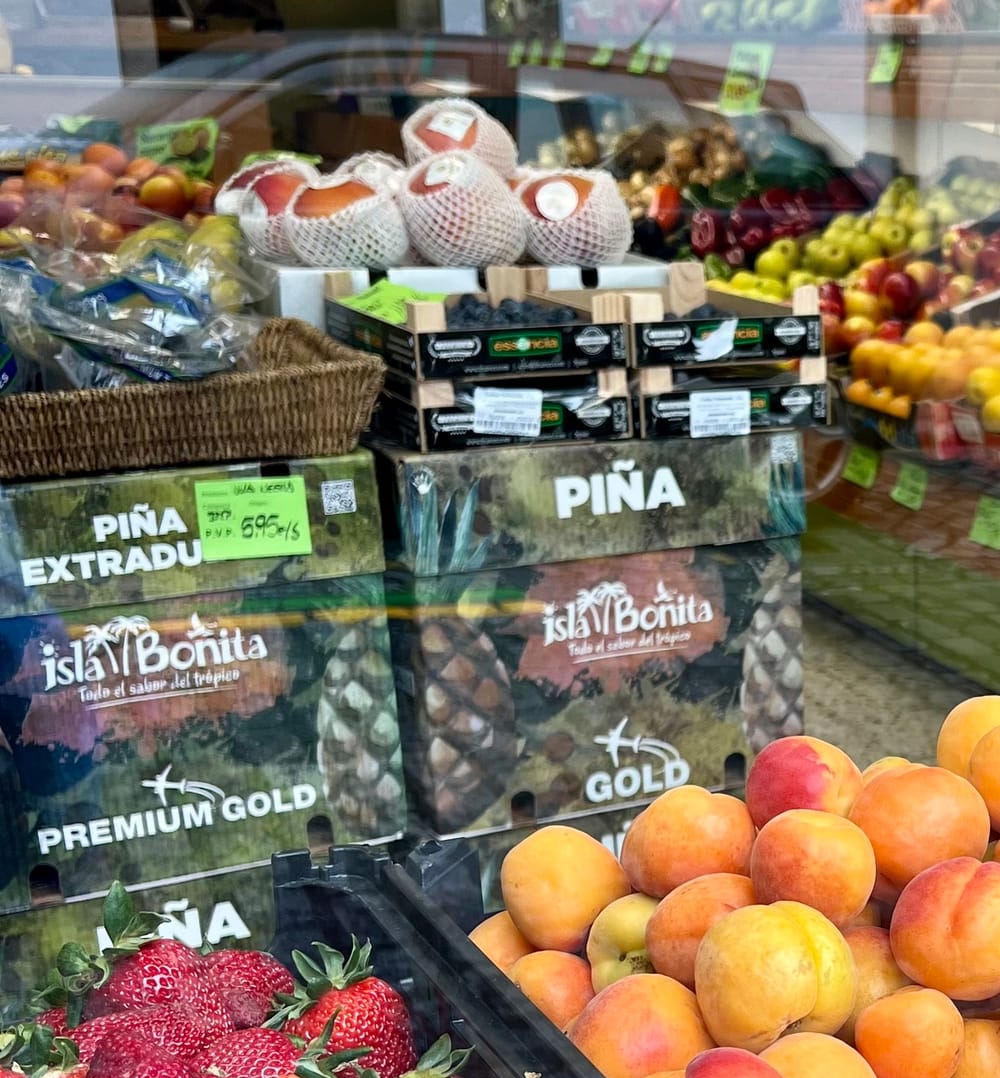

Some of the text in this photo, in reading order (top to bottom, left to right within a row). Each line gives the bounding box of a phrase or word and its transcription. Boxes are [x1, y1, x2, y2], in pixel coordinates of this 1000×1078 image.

[554, 459, 686, 519] PIÑA
[93, 503, 188, 543] PIÑA
[542, 593, 714, 647] isla Bonita
[568, 641, 592, 656] Todo
[596, 640, 604, 653] el
[607, 635, 635, 651] sabor
[638, 633, 654, 647] del
[40, 627, 268, 692] isla Bonita
[78, 668, 240, 702] Todo el sabor del trópico
[585, 758, 690, 803] GOLD
[37, 783, 317, 855] PREMIUM GOLD
